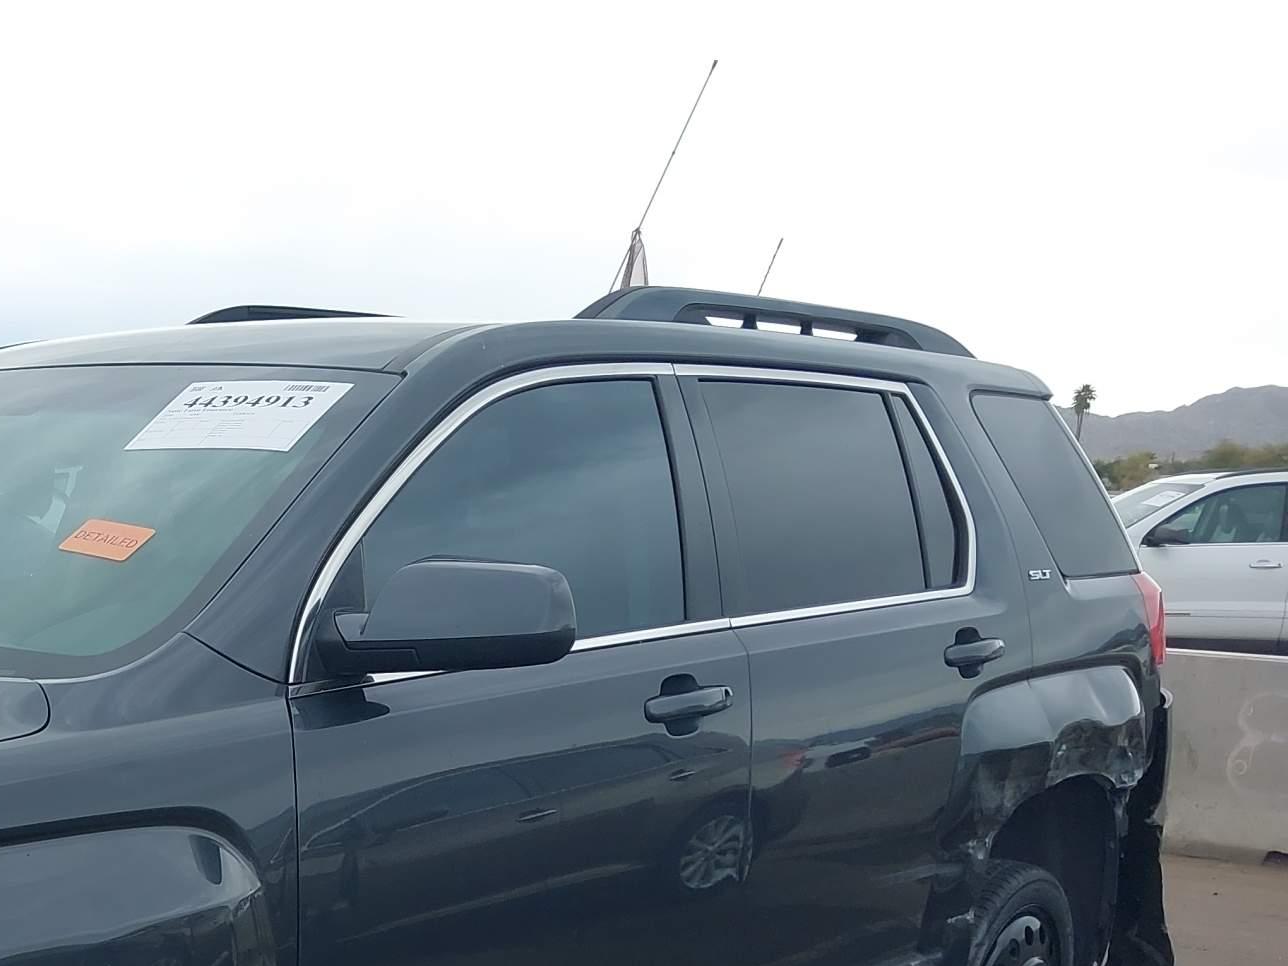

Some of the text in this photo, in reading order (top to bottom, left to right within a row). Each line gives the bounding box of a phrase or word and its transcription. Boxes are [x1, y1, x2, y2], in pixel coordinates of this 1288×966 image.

[183, 394, 314, 410] 44394913
[73, 529, 139, 549] DETAILED
[1028, 569, 1052, 580] SLT
